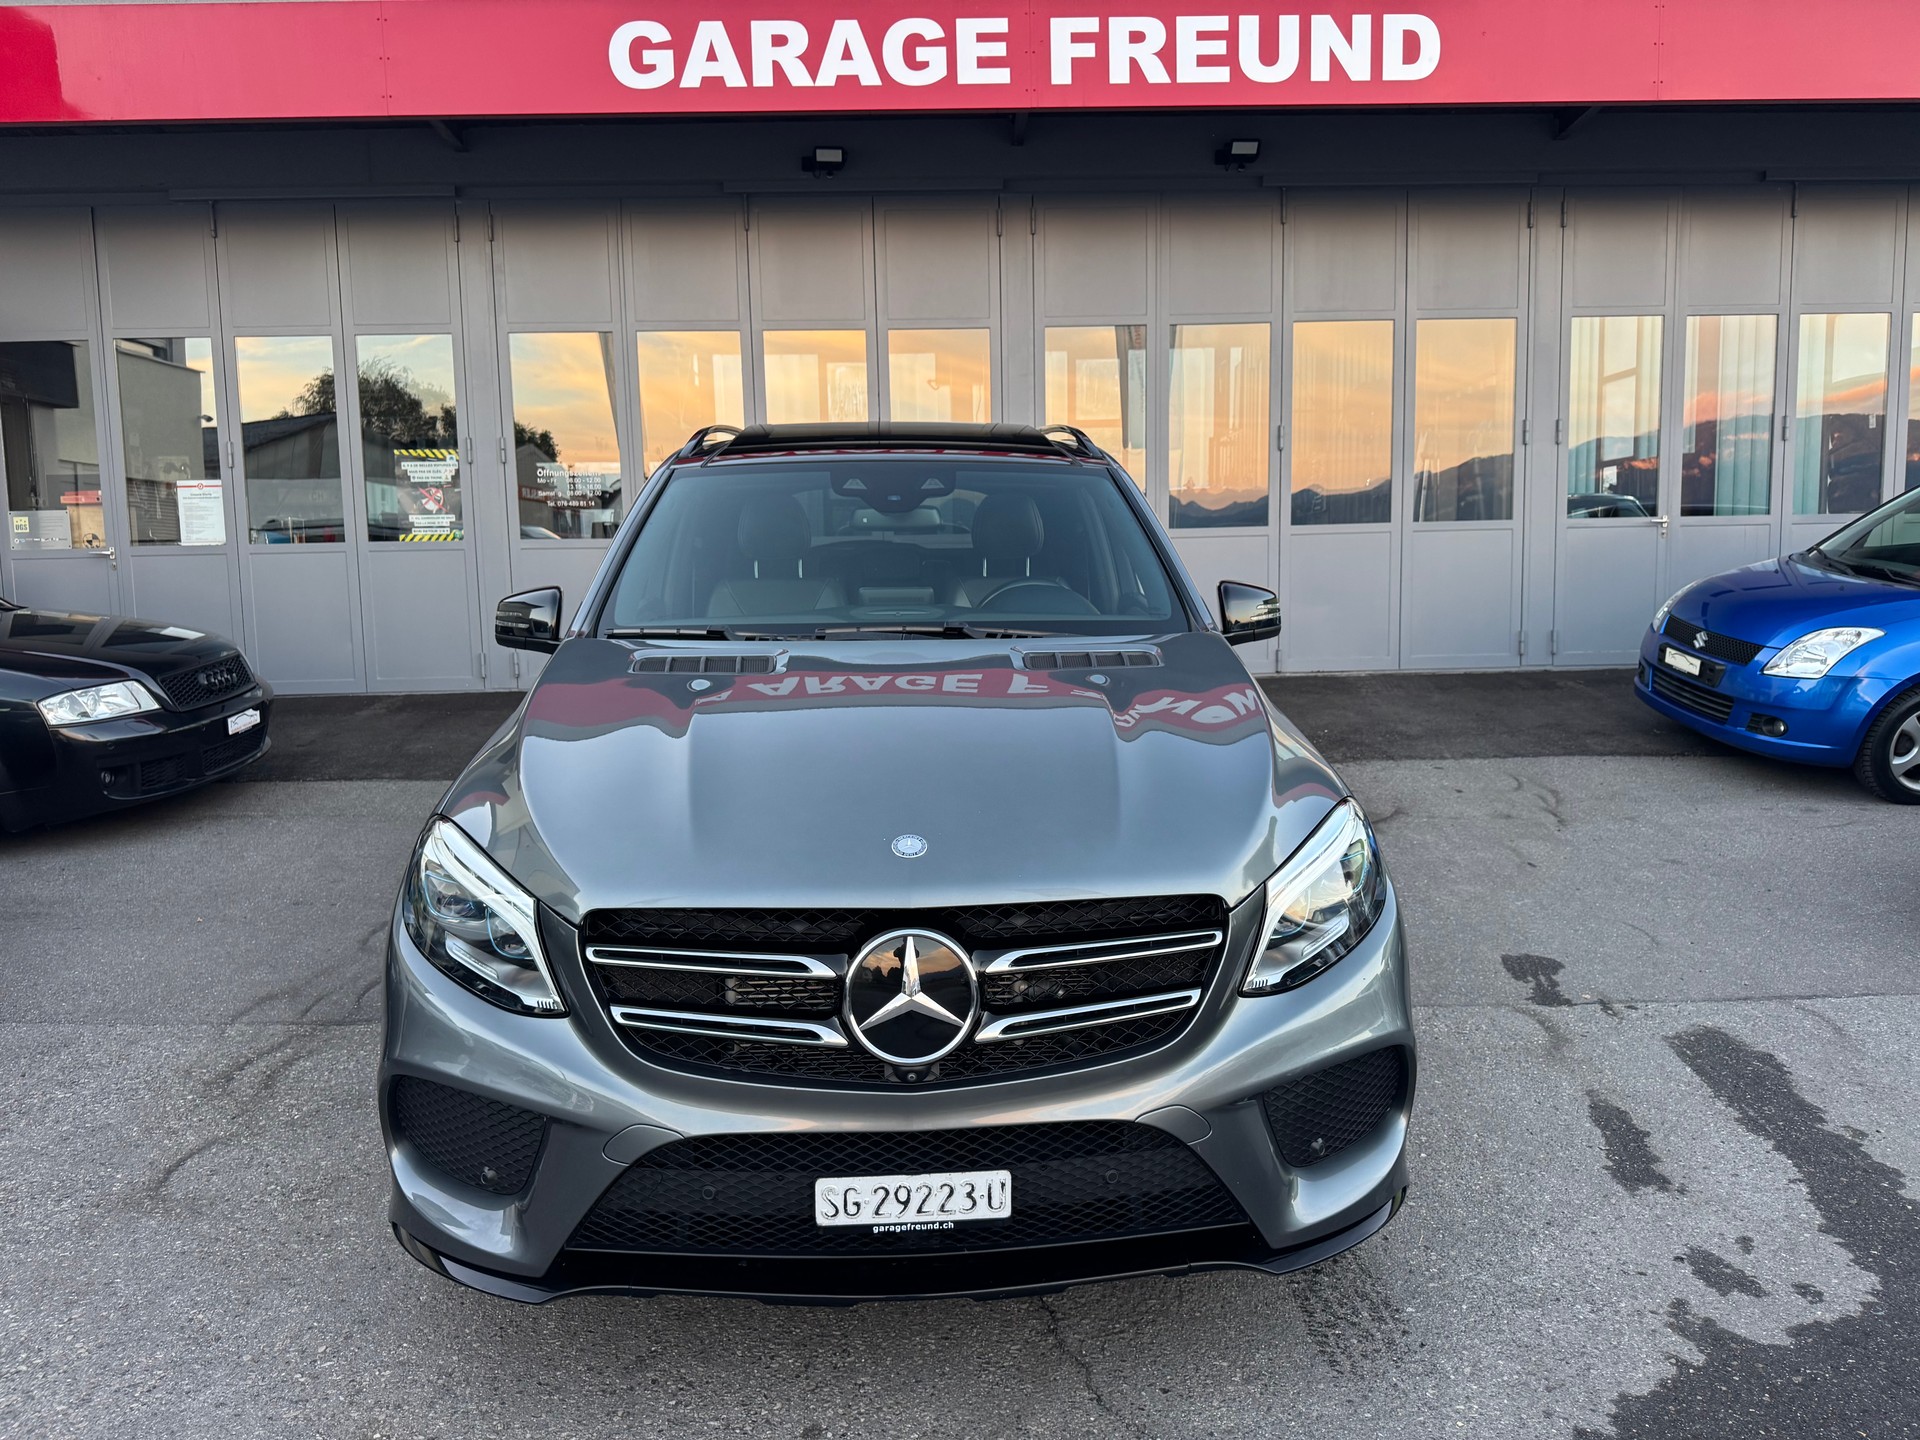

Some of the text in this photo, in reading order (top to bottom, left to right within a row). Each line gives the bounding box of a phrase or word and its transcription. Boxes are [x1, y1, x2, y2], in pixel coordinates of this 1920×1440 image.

[608, 13, 1441, 89] GARAGE FREUND
[873, 1221, 954, 1233] garagefreund.ch
